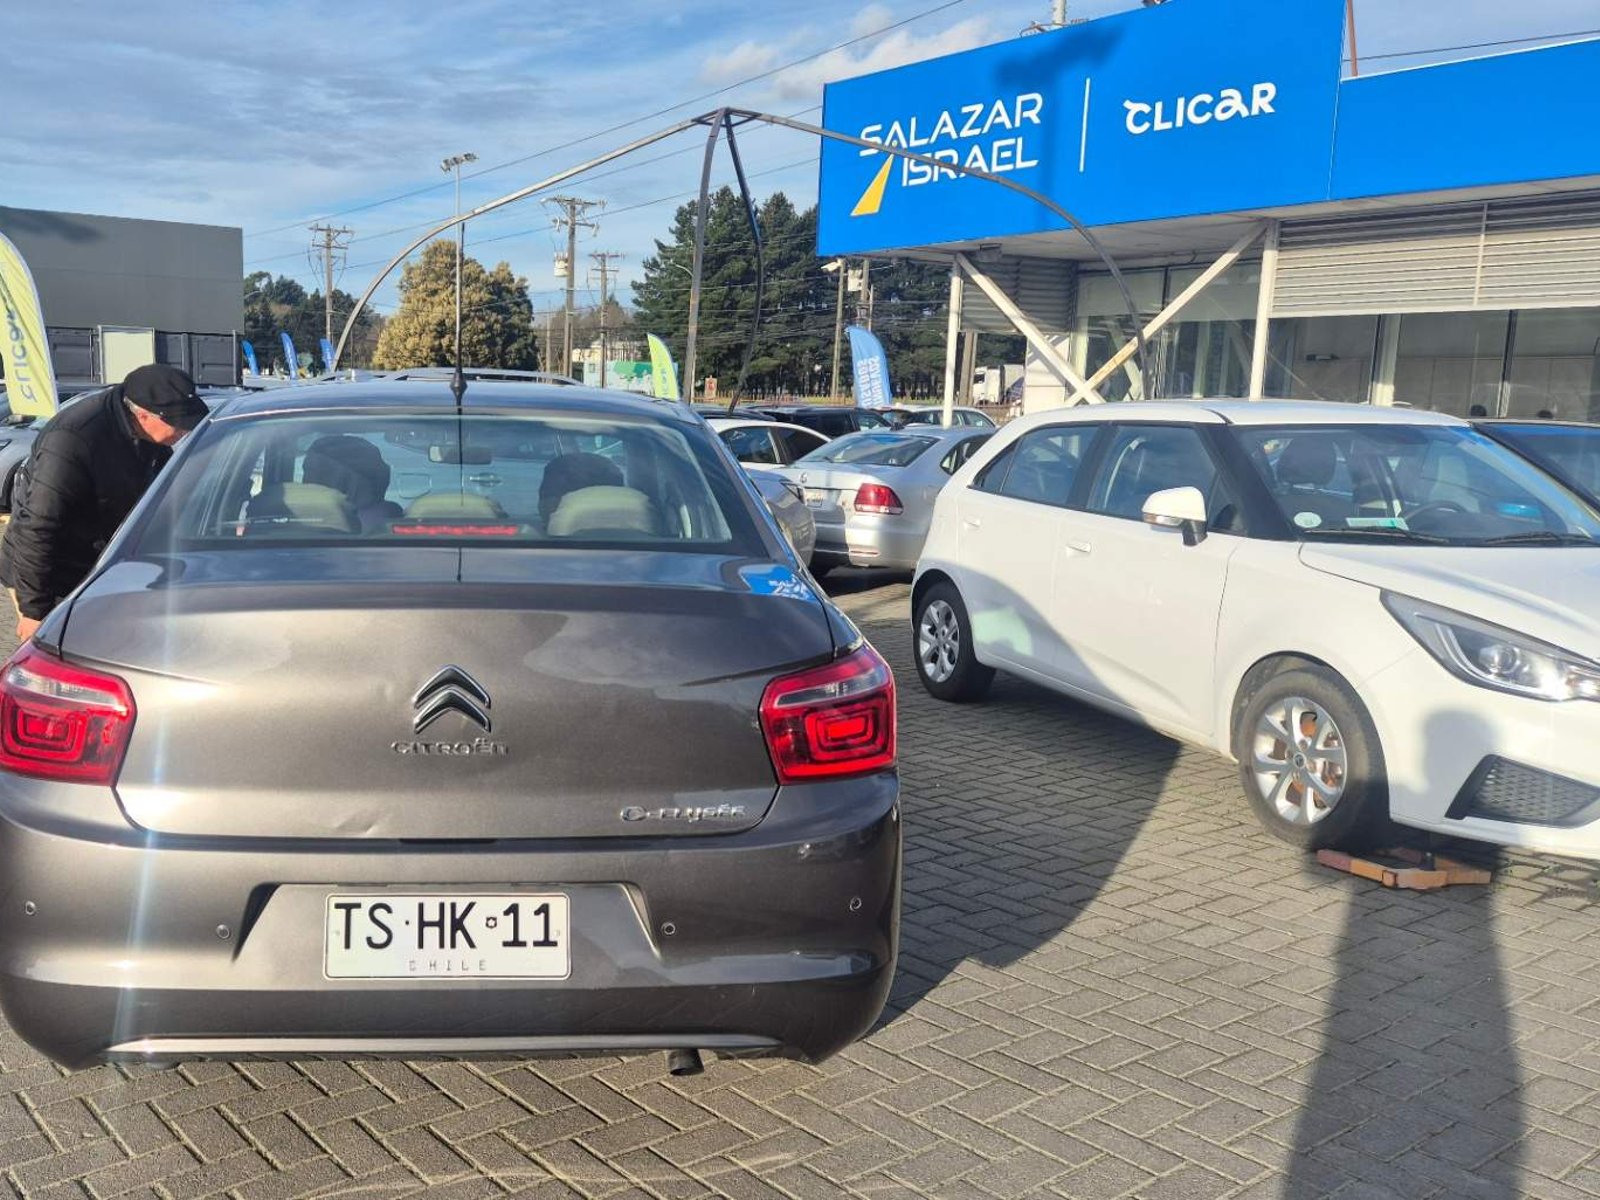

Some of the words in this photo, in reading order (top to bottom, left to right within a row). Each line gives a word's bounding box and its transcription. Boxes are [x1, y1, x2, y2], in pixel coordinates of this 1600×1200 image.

[859, 92, 1043, 157] SALAZAR
[901, 136, 1039, 187] ISRAEL
[408, 959, 487, 971] CHILE
